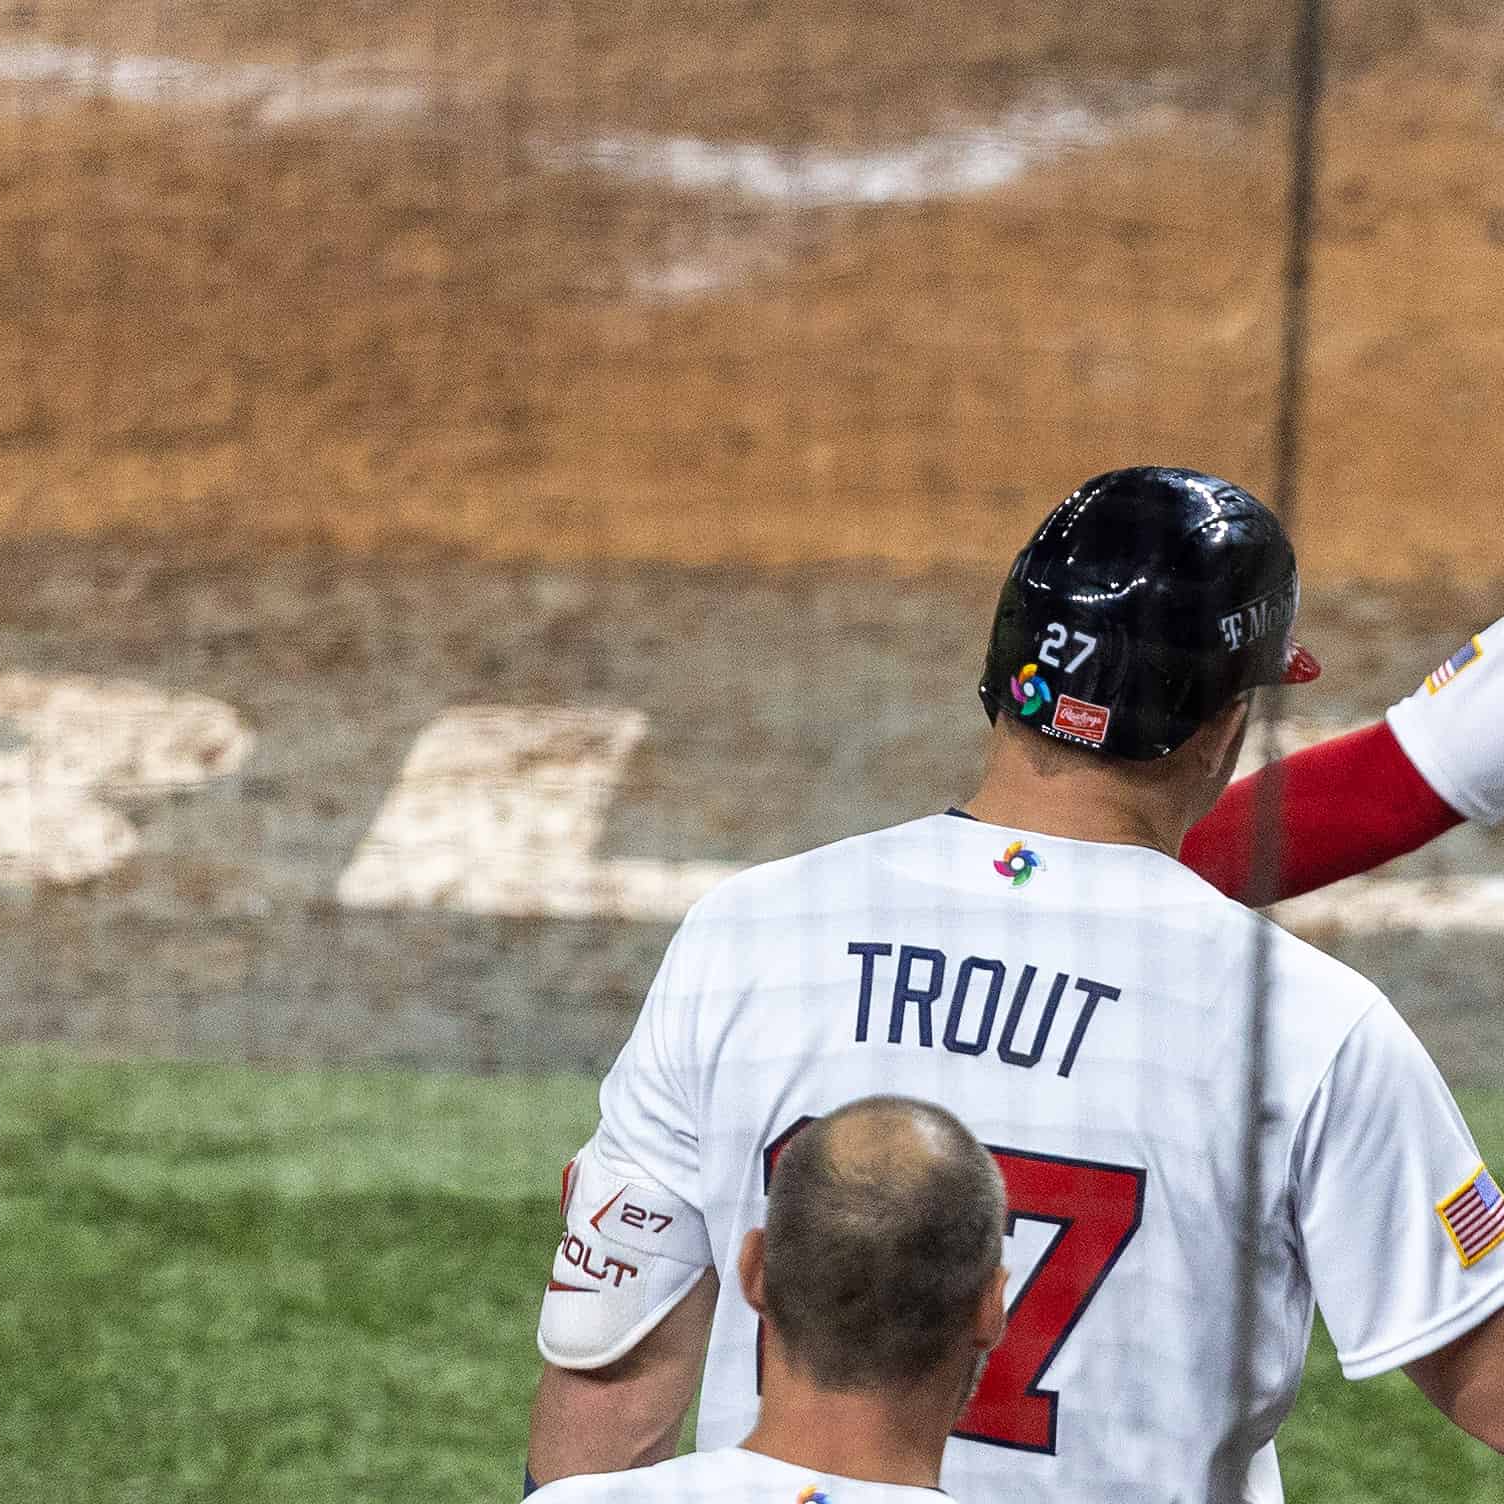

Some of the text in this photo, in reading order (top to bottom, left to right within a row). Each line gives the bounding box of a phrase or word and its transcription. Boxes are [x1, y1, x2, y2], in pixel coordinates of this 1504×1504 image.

[1037, 621, 1098, 674] 27
[846, 941, 1122, 1078] TROUT
[619, 1202, 674, 1234] 27
[755, 1114, 1149, 1457] 7
